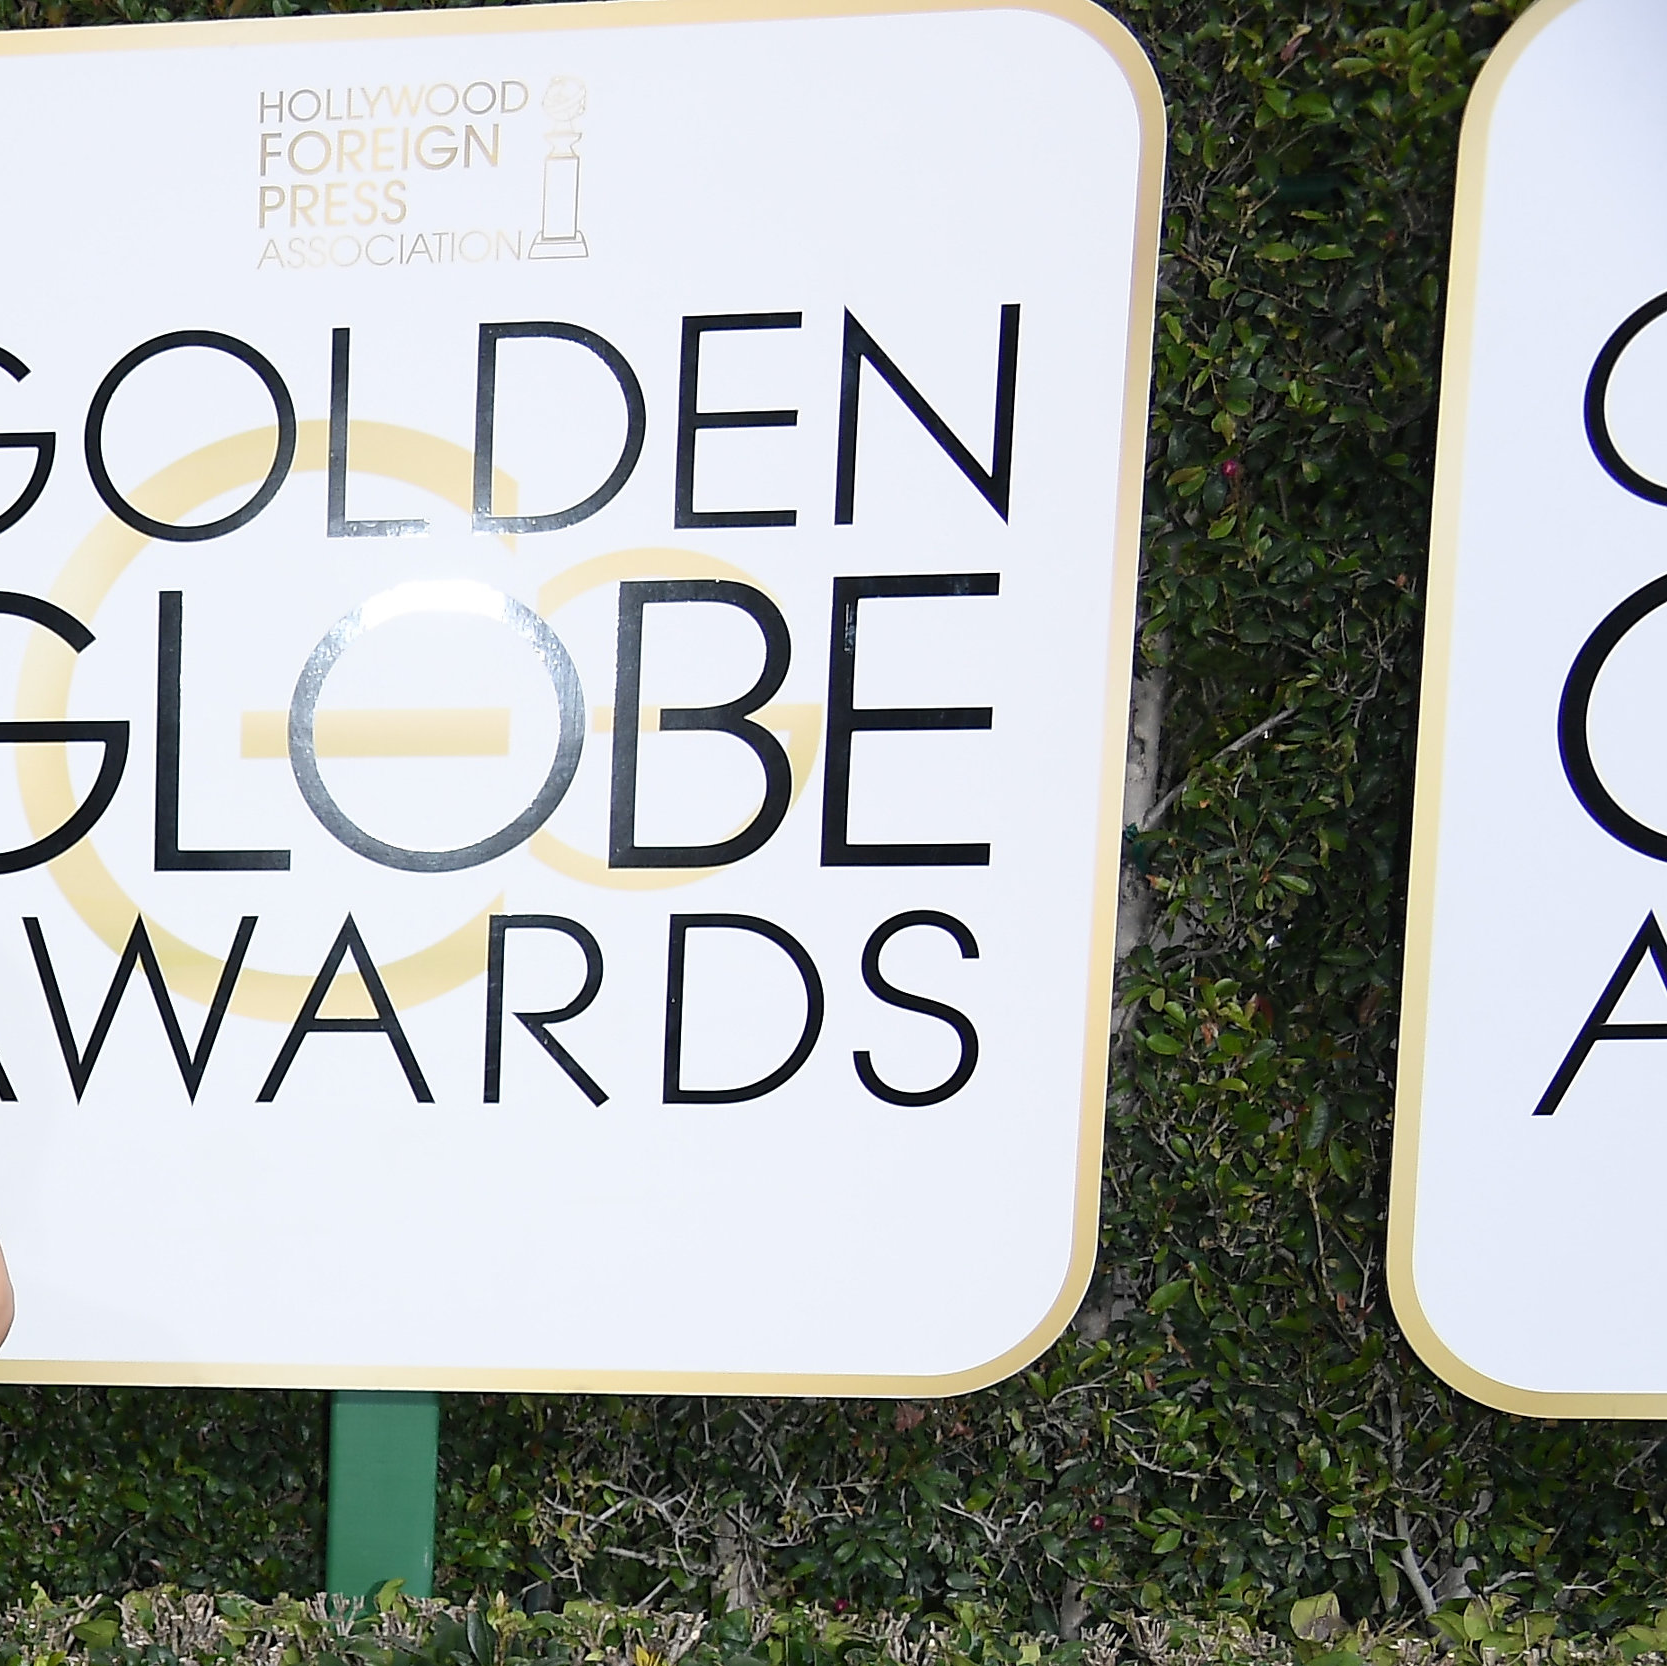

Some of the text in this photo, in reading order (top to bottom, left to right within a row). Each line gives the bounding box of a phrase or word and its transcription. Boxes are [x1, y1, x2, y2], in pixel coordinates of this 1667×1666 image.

[259, 80, 529, 123] HOLLYWOOD
[259, 123, 500, 177] FOREIGN
[259, 180, 408, 228] PRESS
[256, 230, 524, 270] ASSOCIATION
